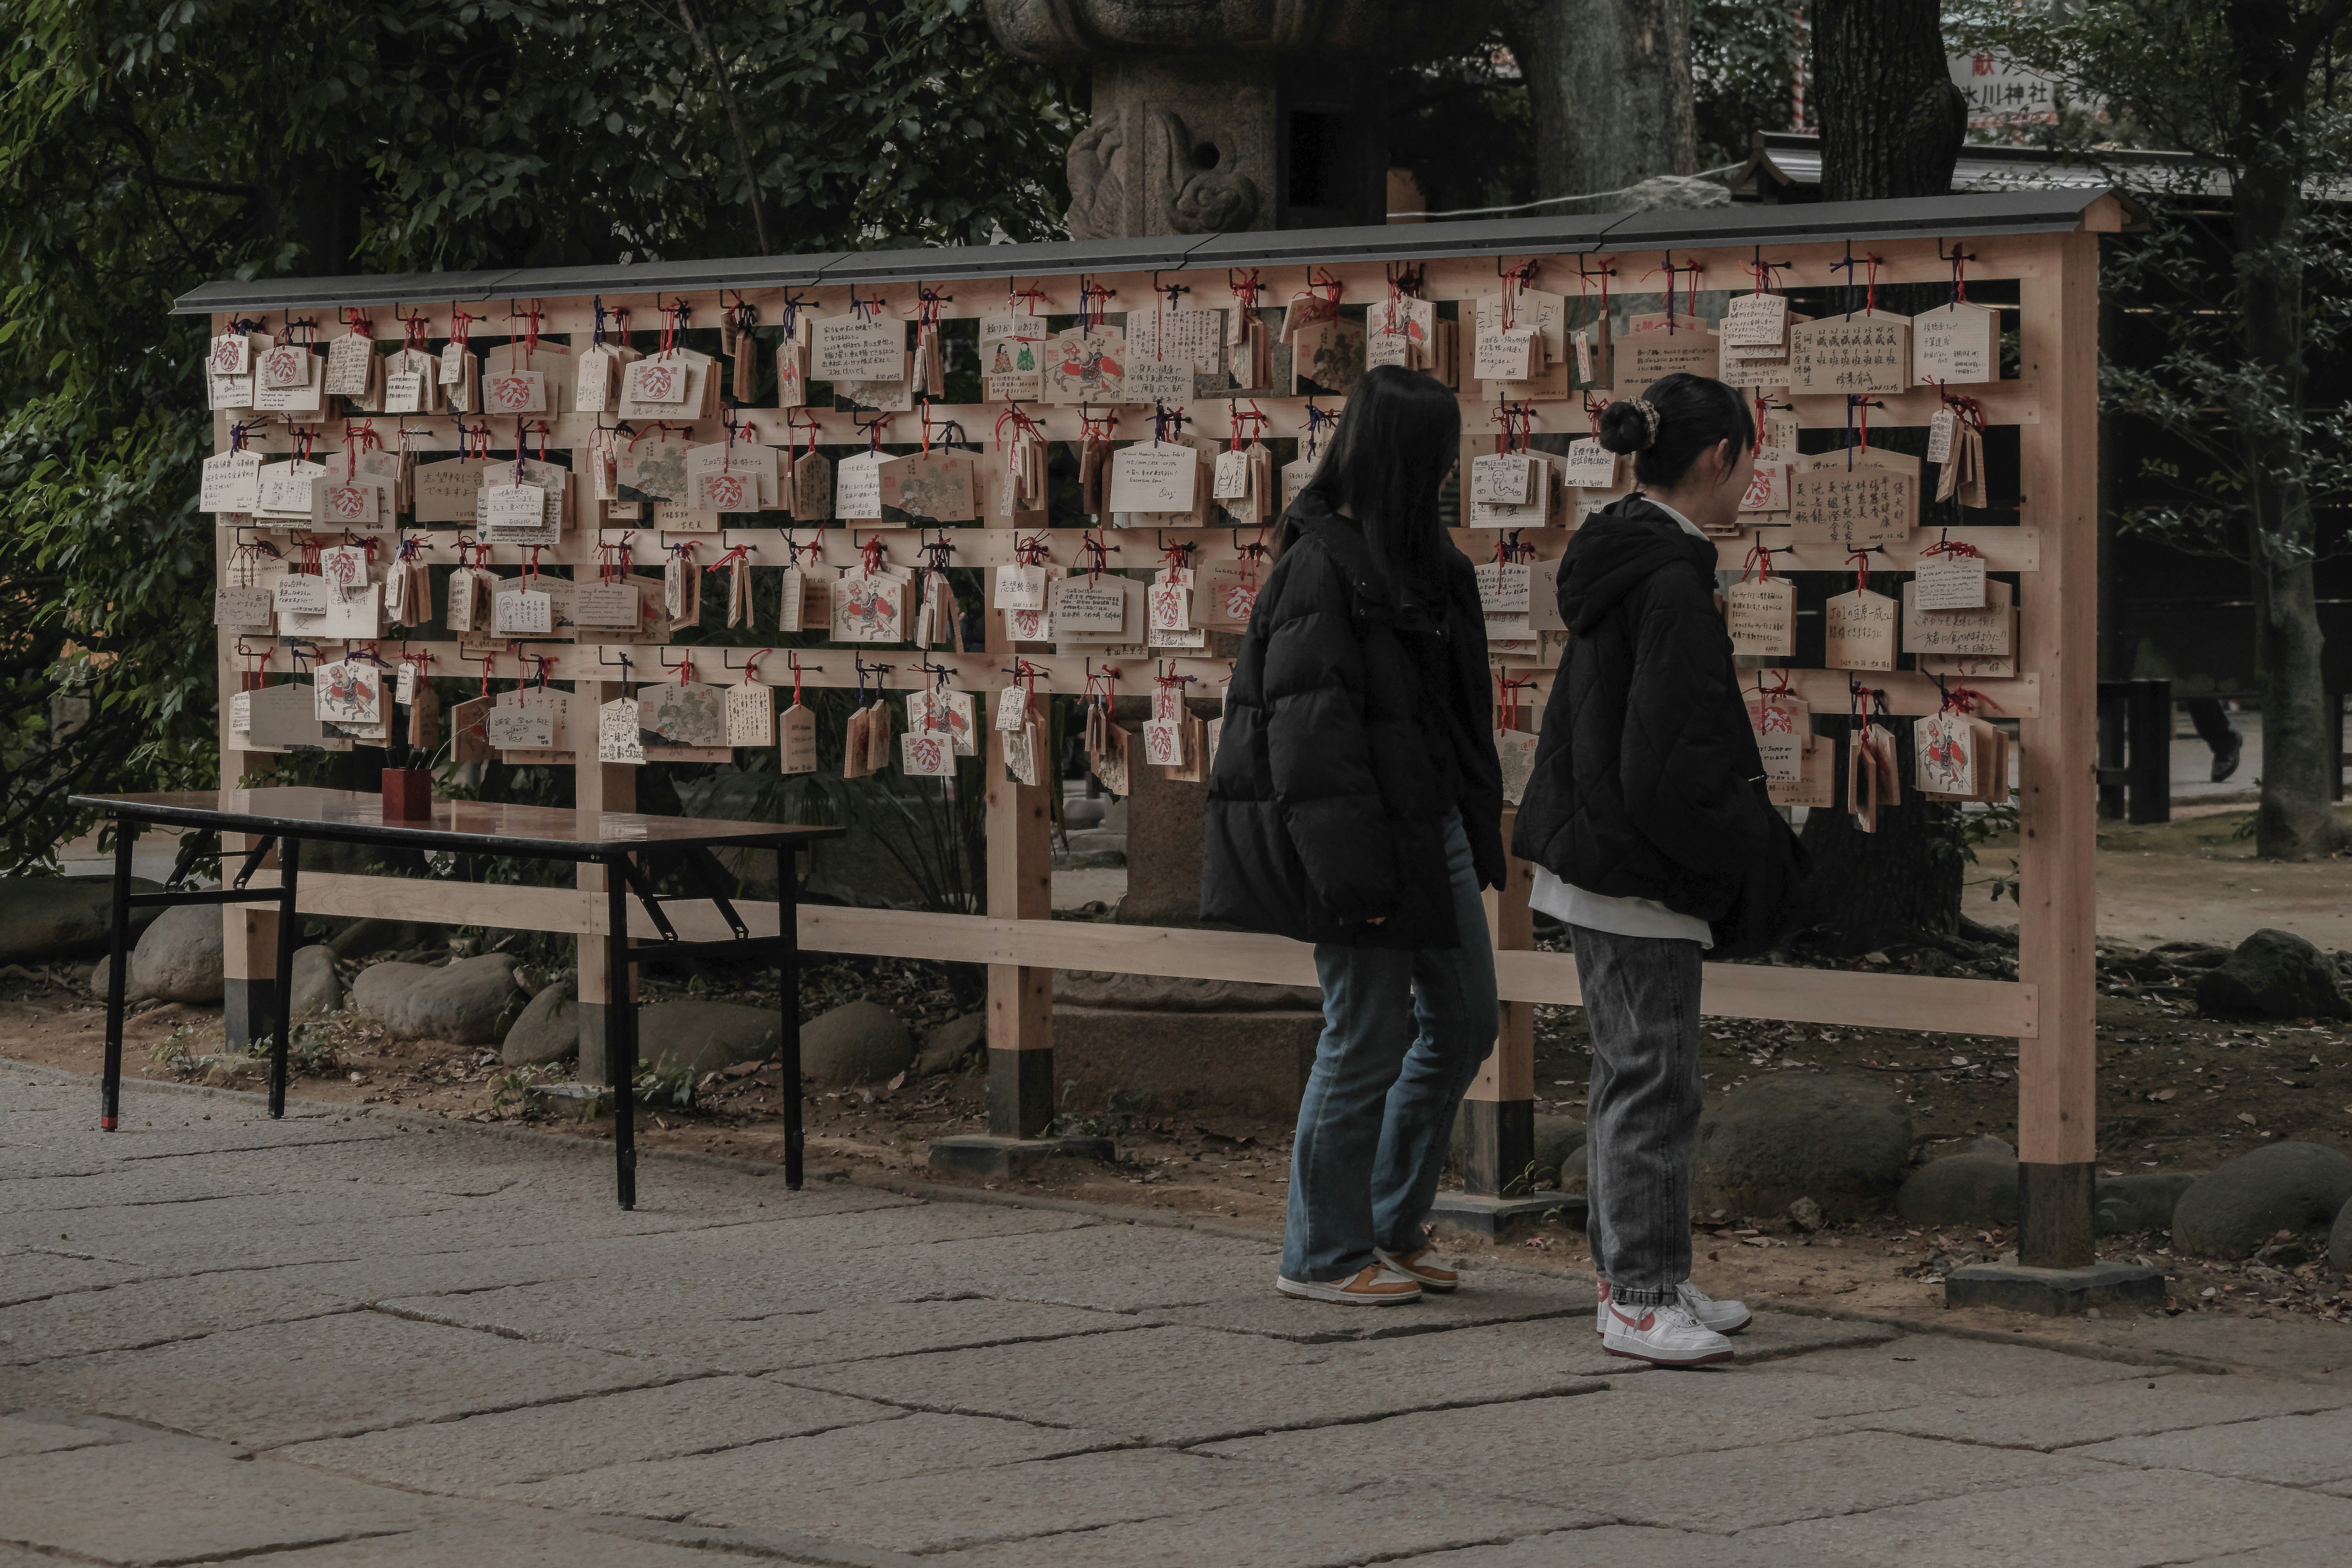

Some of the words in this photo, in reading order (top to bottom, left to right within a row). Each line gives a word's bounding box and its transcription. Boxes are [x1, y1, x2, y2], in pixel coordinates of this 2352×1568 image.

[1001, 580, 1039, 594] 志望校合格
